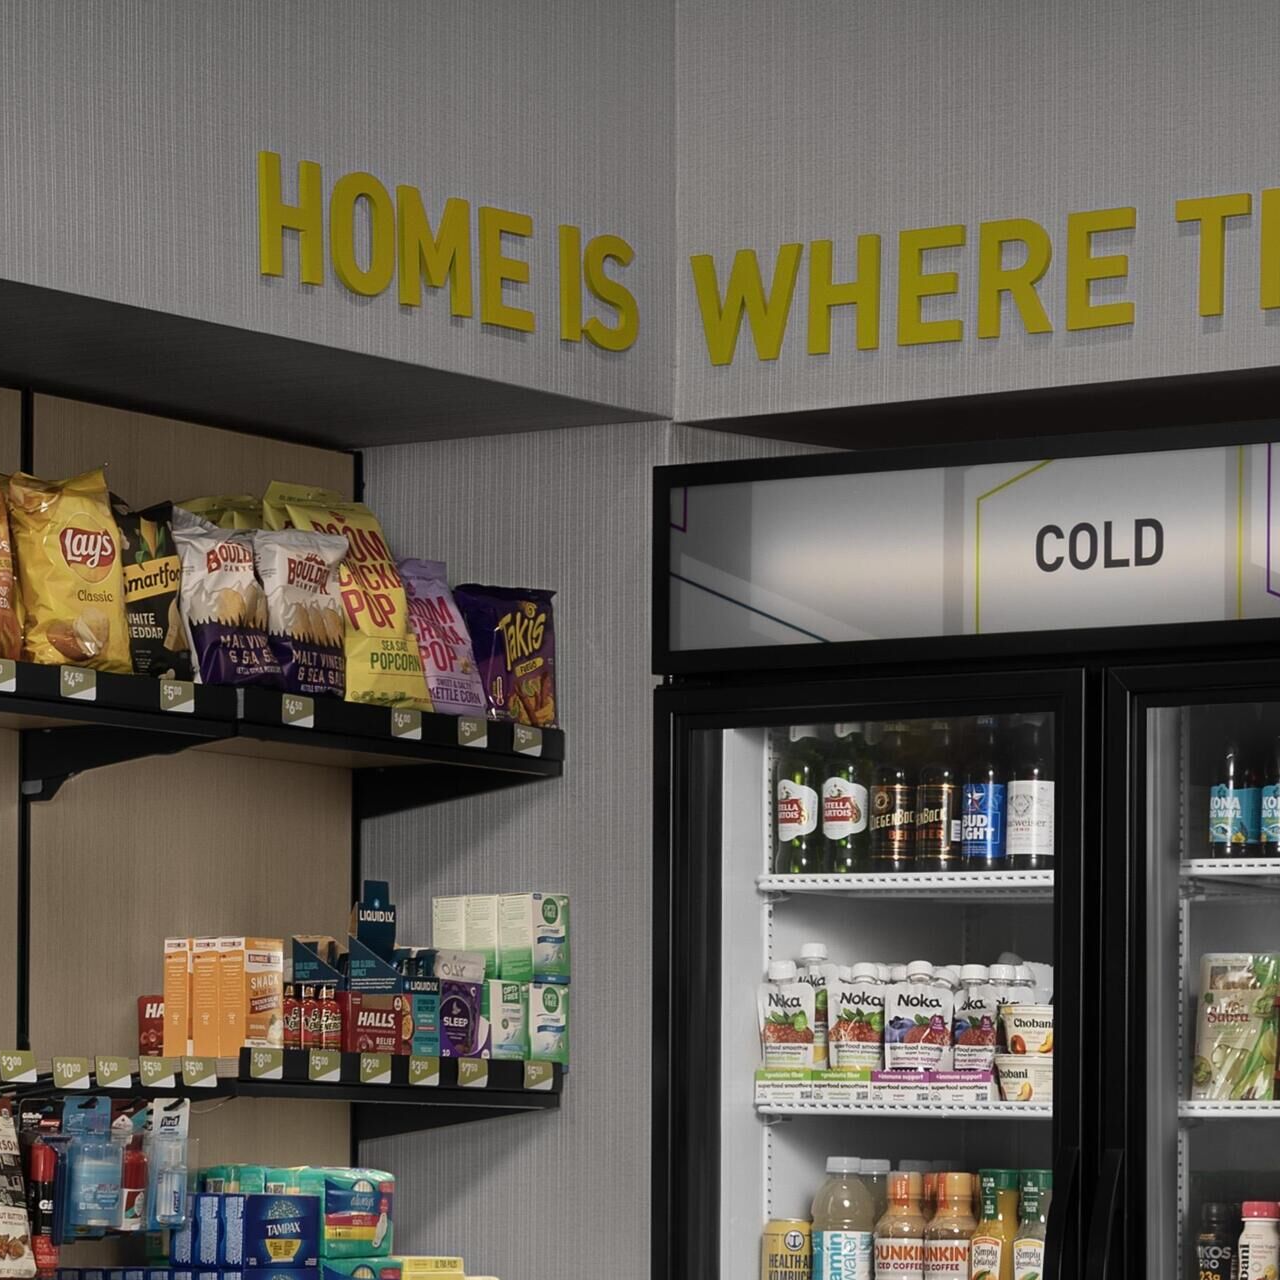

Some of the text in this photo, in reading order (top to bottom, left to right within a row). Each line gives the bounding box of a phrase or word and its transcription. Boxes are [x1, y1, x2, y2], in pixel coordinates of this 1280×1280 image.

[257, 151, 535, 333] HOME
[559, 225, 639, 351] IS
[691, 207, 1137, 367] WHERE
[64, 530, 112, 566] Lay's
[1035, 518, 1164, 572] COLD
[77, 590, 113, 603] Classic
[370, 650, 420, 672] POPCORN
[898, 993, 941, 1008] Noka
[444, 1017, 468, 1027] SLEEP
[1207, 1007, 1249, 1023] Sabra
[266, 1222, 300, 1236] TAMPAX
[931, 1263, 959, 1271] COFFEE
